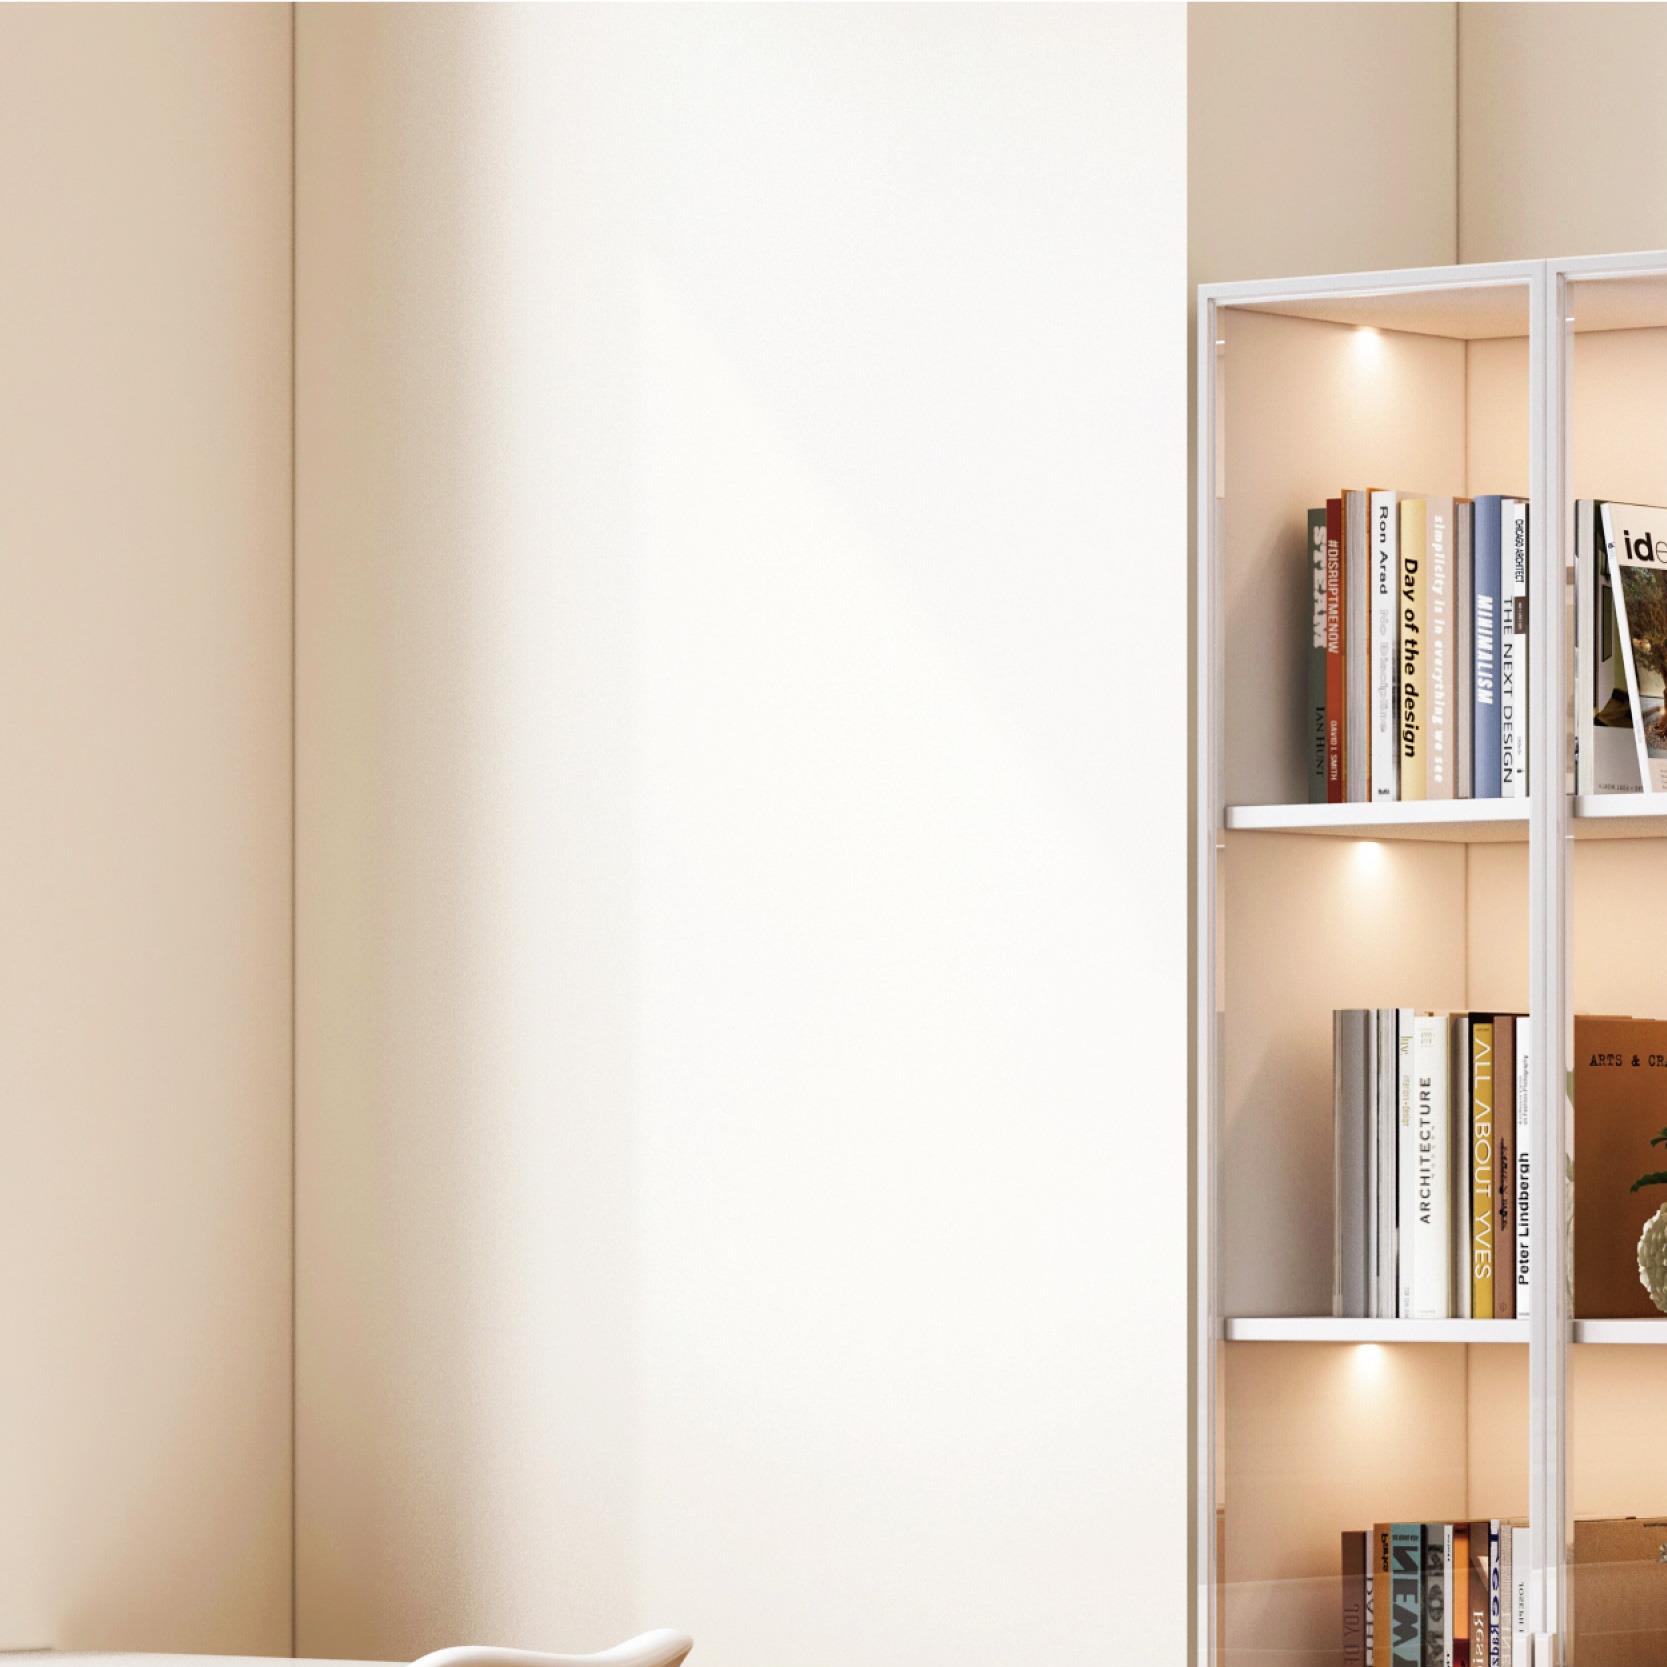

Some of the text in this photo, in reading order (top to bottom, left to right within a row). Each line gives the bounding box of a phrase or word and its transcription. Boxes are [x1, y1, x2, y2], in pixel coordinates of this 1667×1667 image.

[1313, 525, 1327, 648] STEAM
[1328, 539, 1339, 654] #DISRUPTMENOW
[1380, 506, 1389, 595] Ron Arad
[1515, 519, 1524, 583] CHICAGO ARCHITECT
[1402, 558, 1419, 758] Day of the design
[1431, 515, 1445, 783] simplicity is in everything we see
[1478, 594, 1493, 705] MINIMALISM
[1504, 597, 1513, 783] THE NEXT DESIGN
[1315, 706, 1325, 777] IAN HUNT
[1474, 1038, 1491, 1088] ALL
[1589, 1054, 1623, 1067] ARTS
[1632, 1055, 1640, 1067] &
[1419, 1077, 1431, 1225] ARCHITECTURE
[1474, 1101, 1491, 1196] ABOUT
[1474, 1210, 1491, 1280] YVES
[1518, 1153, 1530, 1285] Peter Lindbergh
